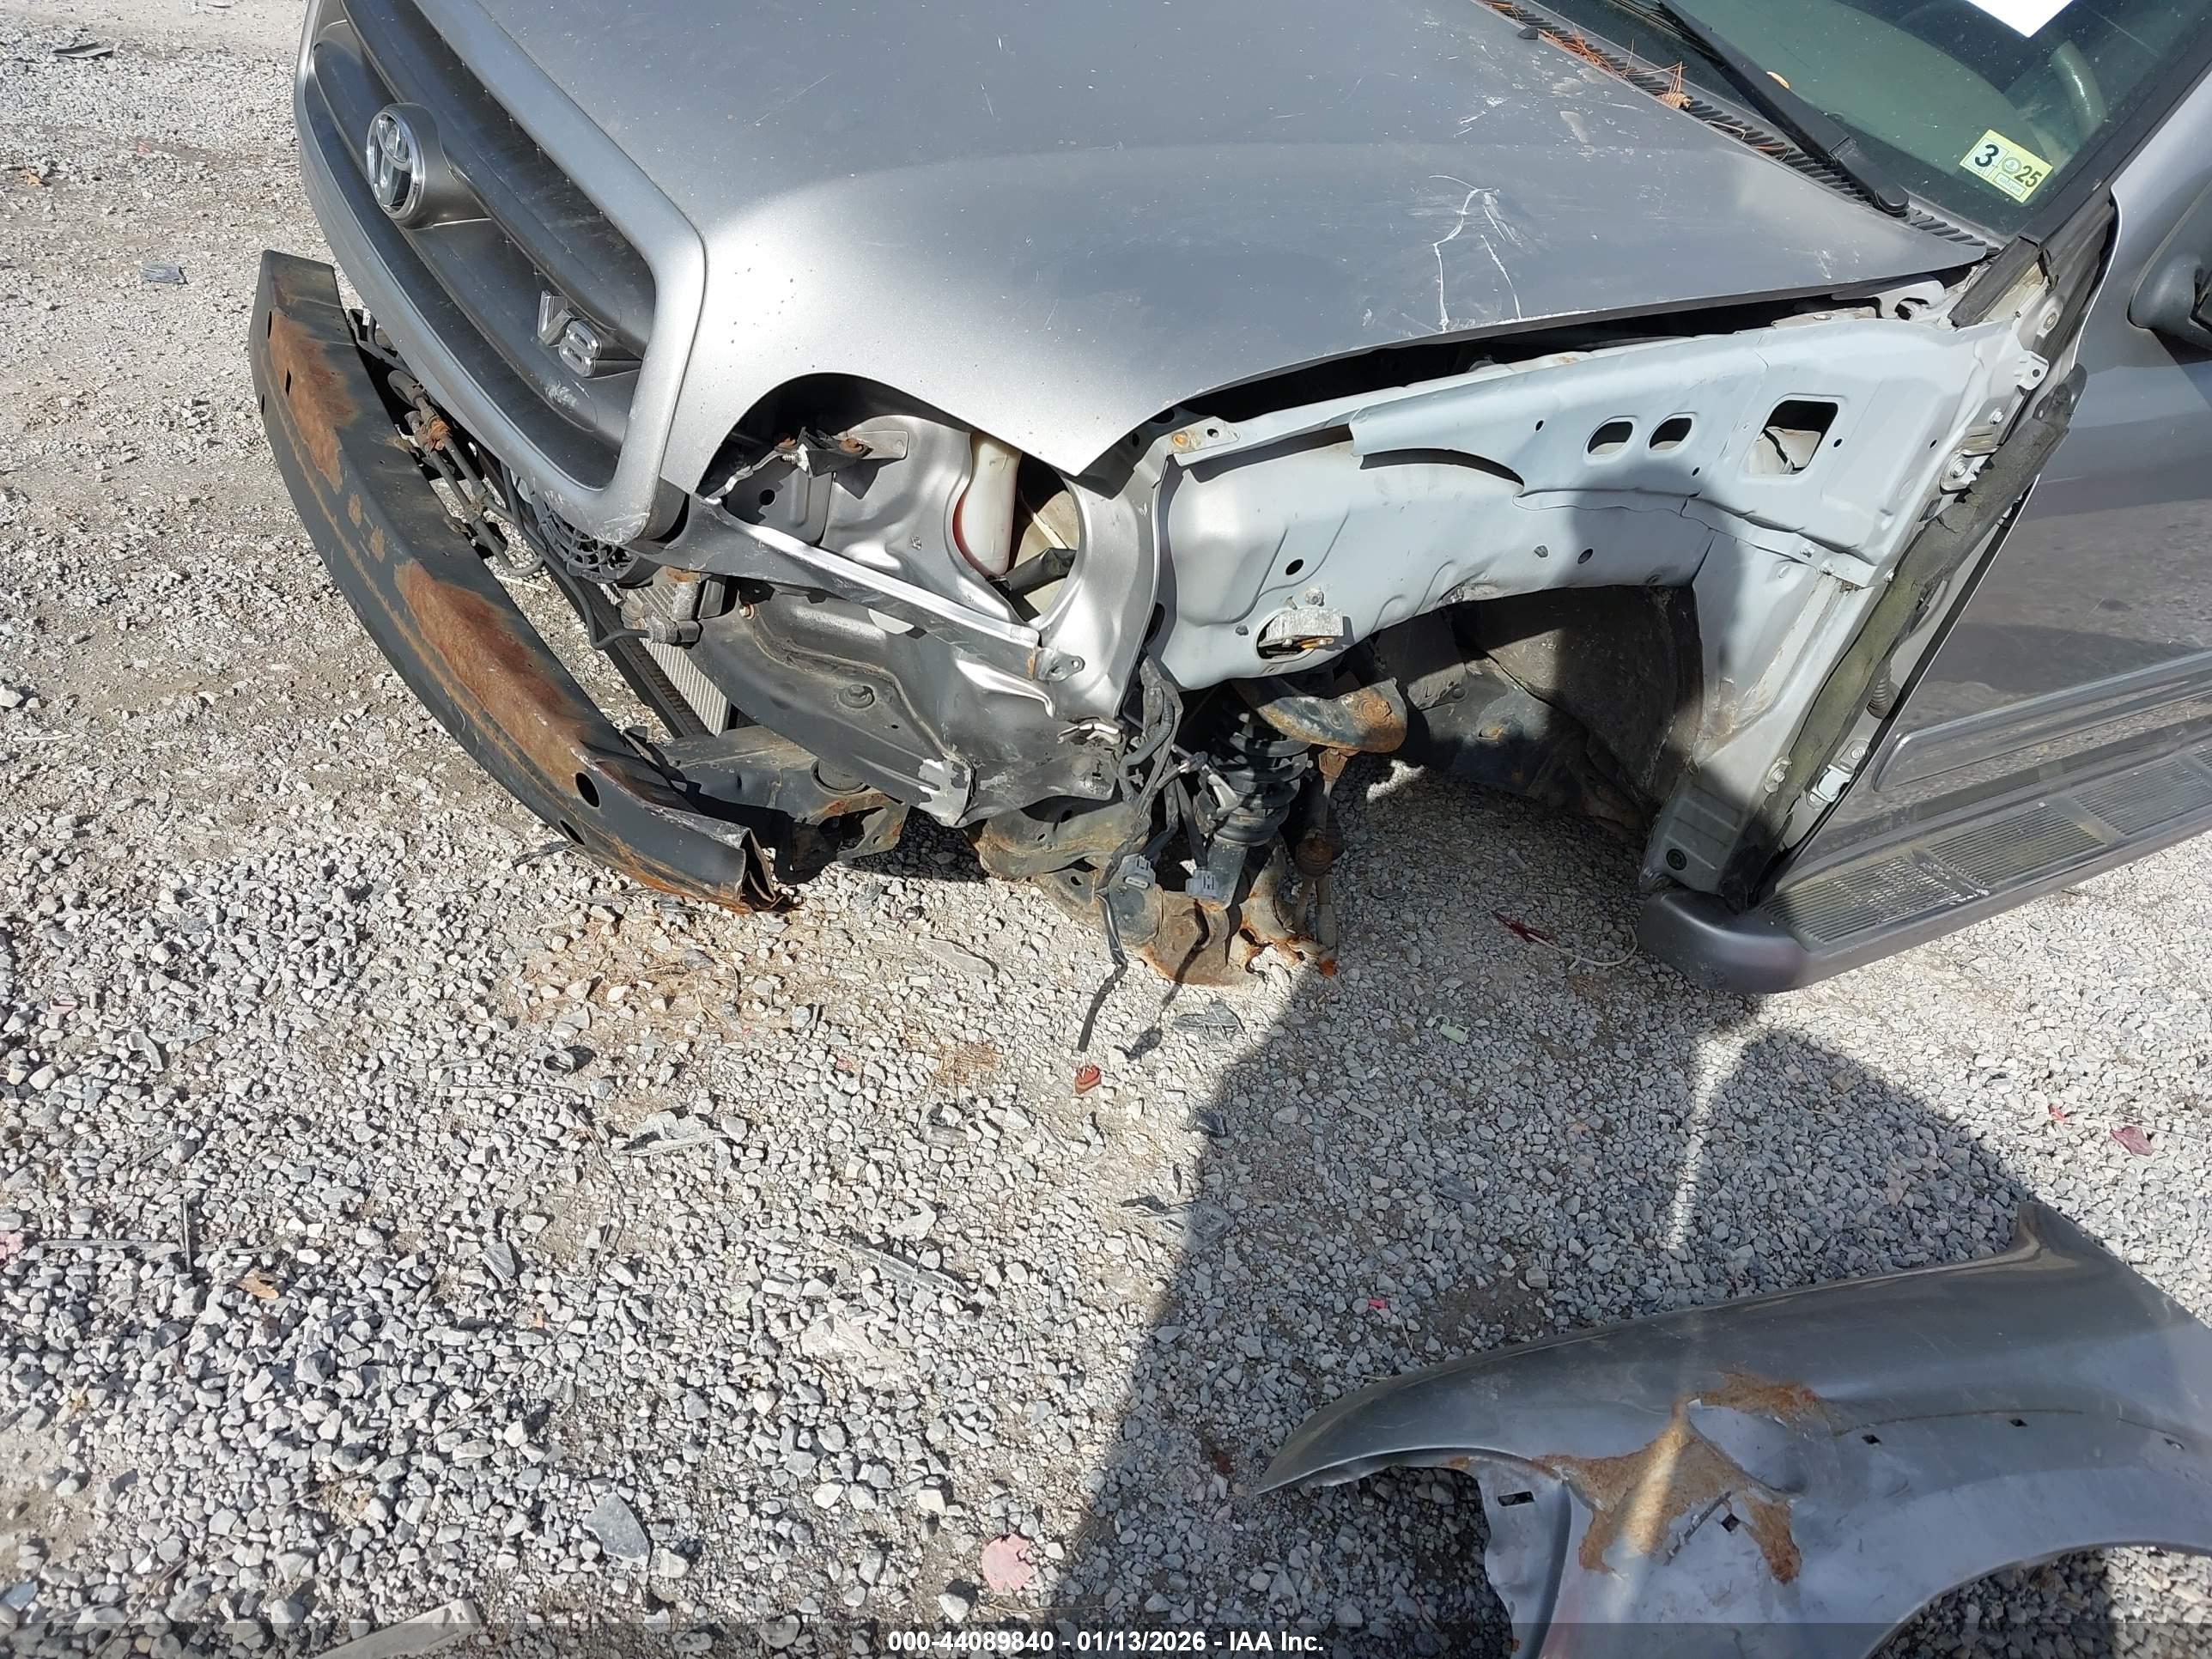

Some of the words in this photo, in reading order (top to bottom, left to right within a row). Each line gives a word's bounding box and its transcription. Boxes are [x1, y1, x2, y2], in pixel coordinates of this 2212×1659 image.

[1974, 143, 1999, 167] 3
[2014, 165, 2043, 188] 25
[538, 290, 601, 378] V8
